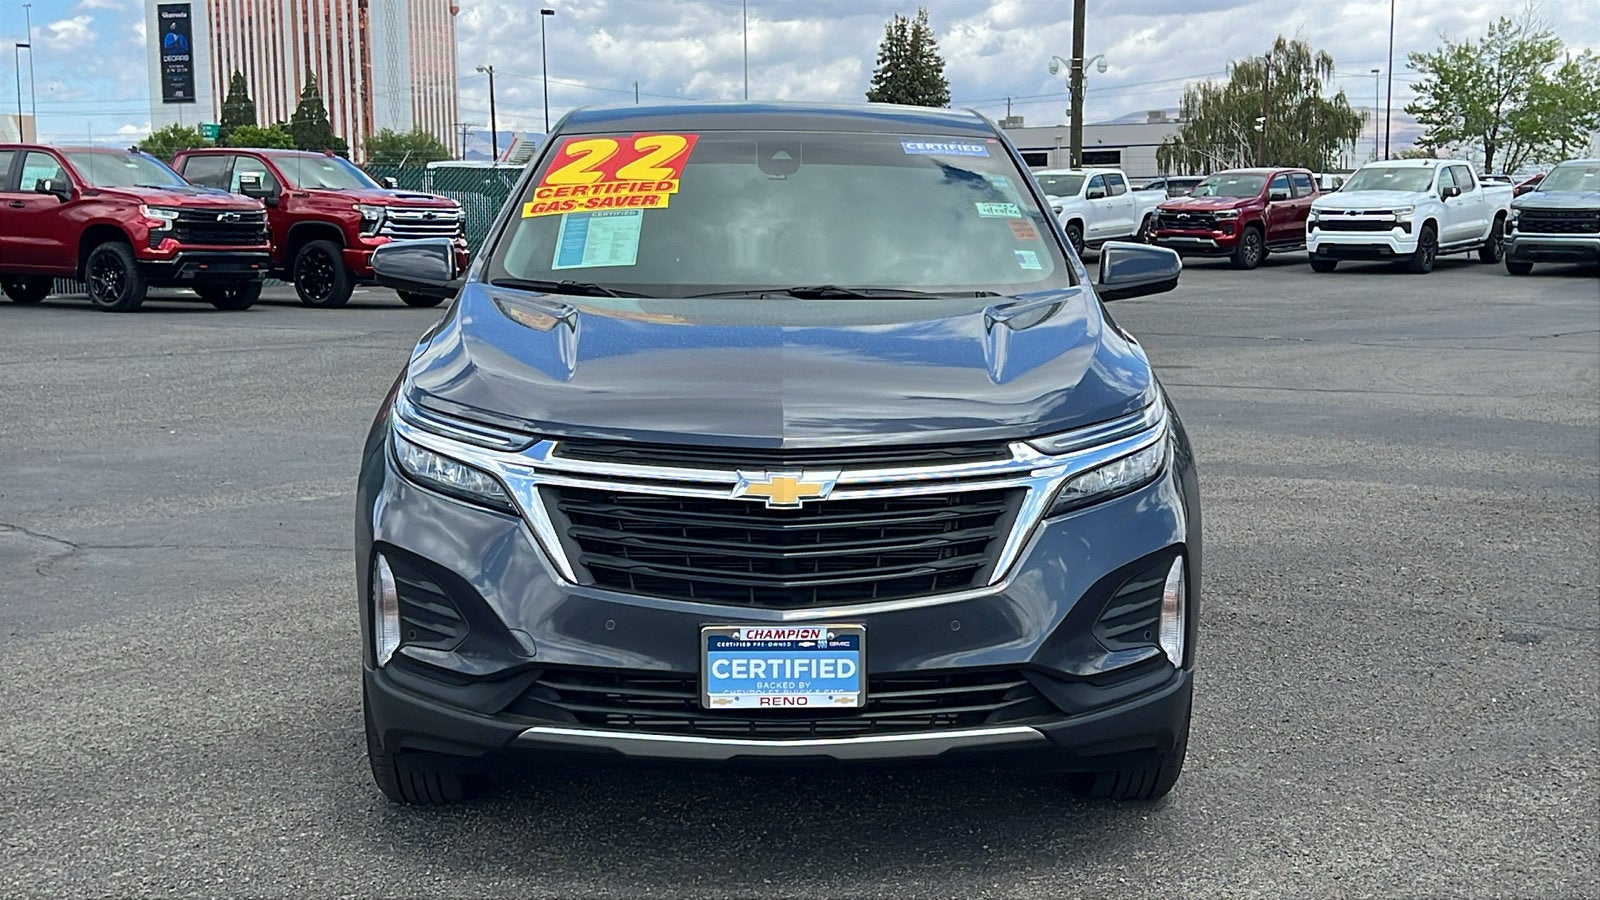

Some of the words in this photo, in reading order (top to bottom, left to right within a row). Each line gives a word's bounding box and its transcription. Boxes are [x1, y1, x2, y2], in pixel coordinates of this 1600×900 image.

[905, 143, 982, 152] CERTIFIED
[545, 134, 690, 185] 22
[535, 180, 675, 199] CERTIFIED
[530, 194, 661, 215] GAS-SAVER
[746, 629, 821, 640] CHAMPION
[711, 659, 855, 679] CERTIFIED
[756, 681, 796, 690] BACKED
[798, 681, 812, 690] BY
[759, 697, 808, 706] RENO
